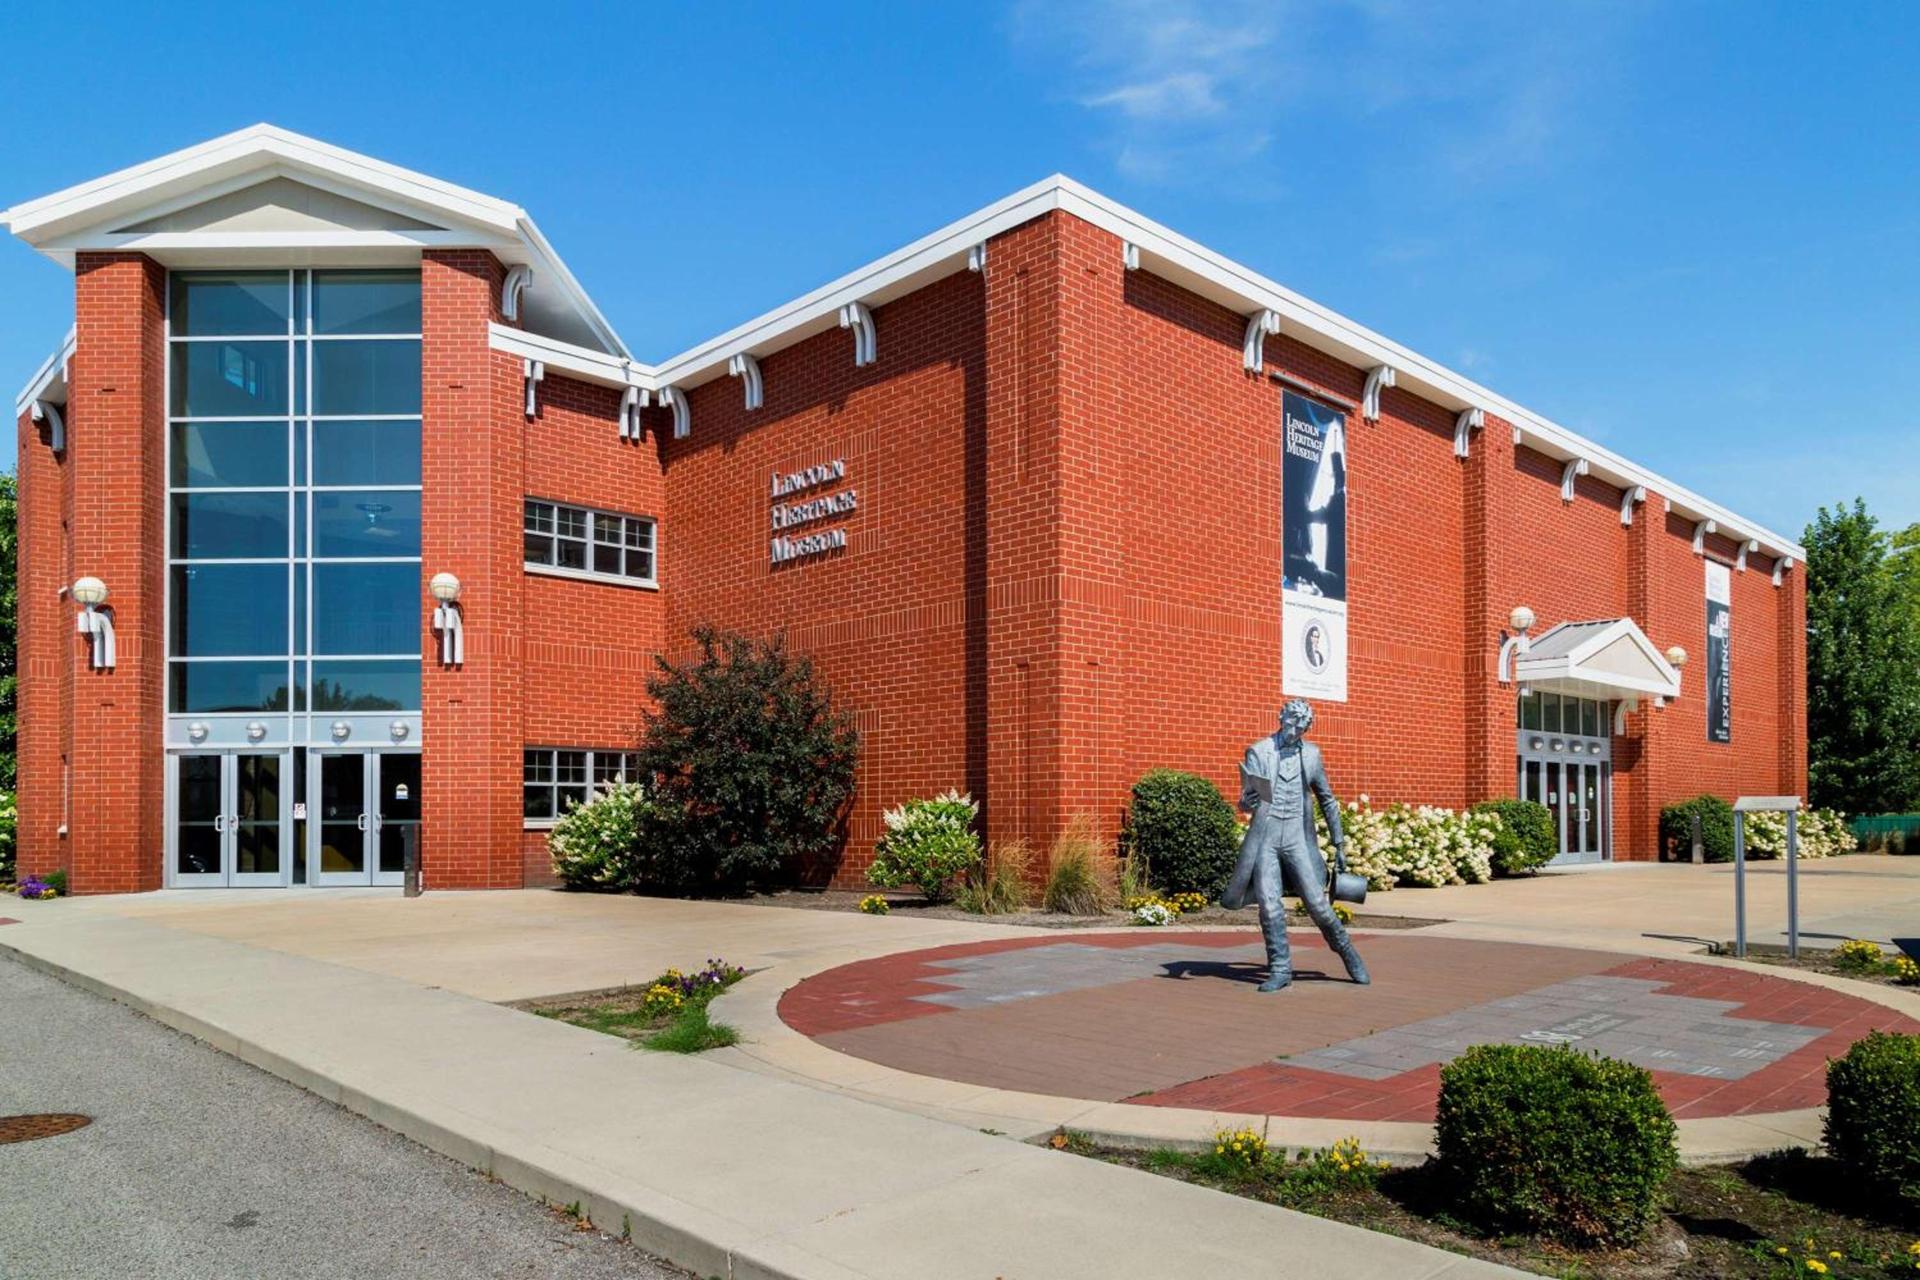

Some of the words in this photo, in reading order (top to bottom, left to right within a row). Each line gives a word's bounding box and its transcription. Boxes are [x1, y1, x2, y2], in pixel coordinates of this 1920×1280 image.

[1286, 413, 1319, 437] LINCOLN
[1287, 426, 1323, 451] HERITAGE
[1286, 439, 1319, 463] MUSEUM
[771, 459, 845, 497] LINCOLN
[771, 489, 857, 529] HERITAGE
[771, 528, 847, 562] MUSEUM
